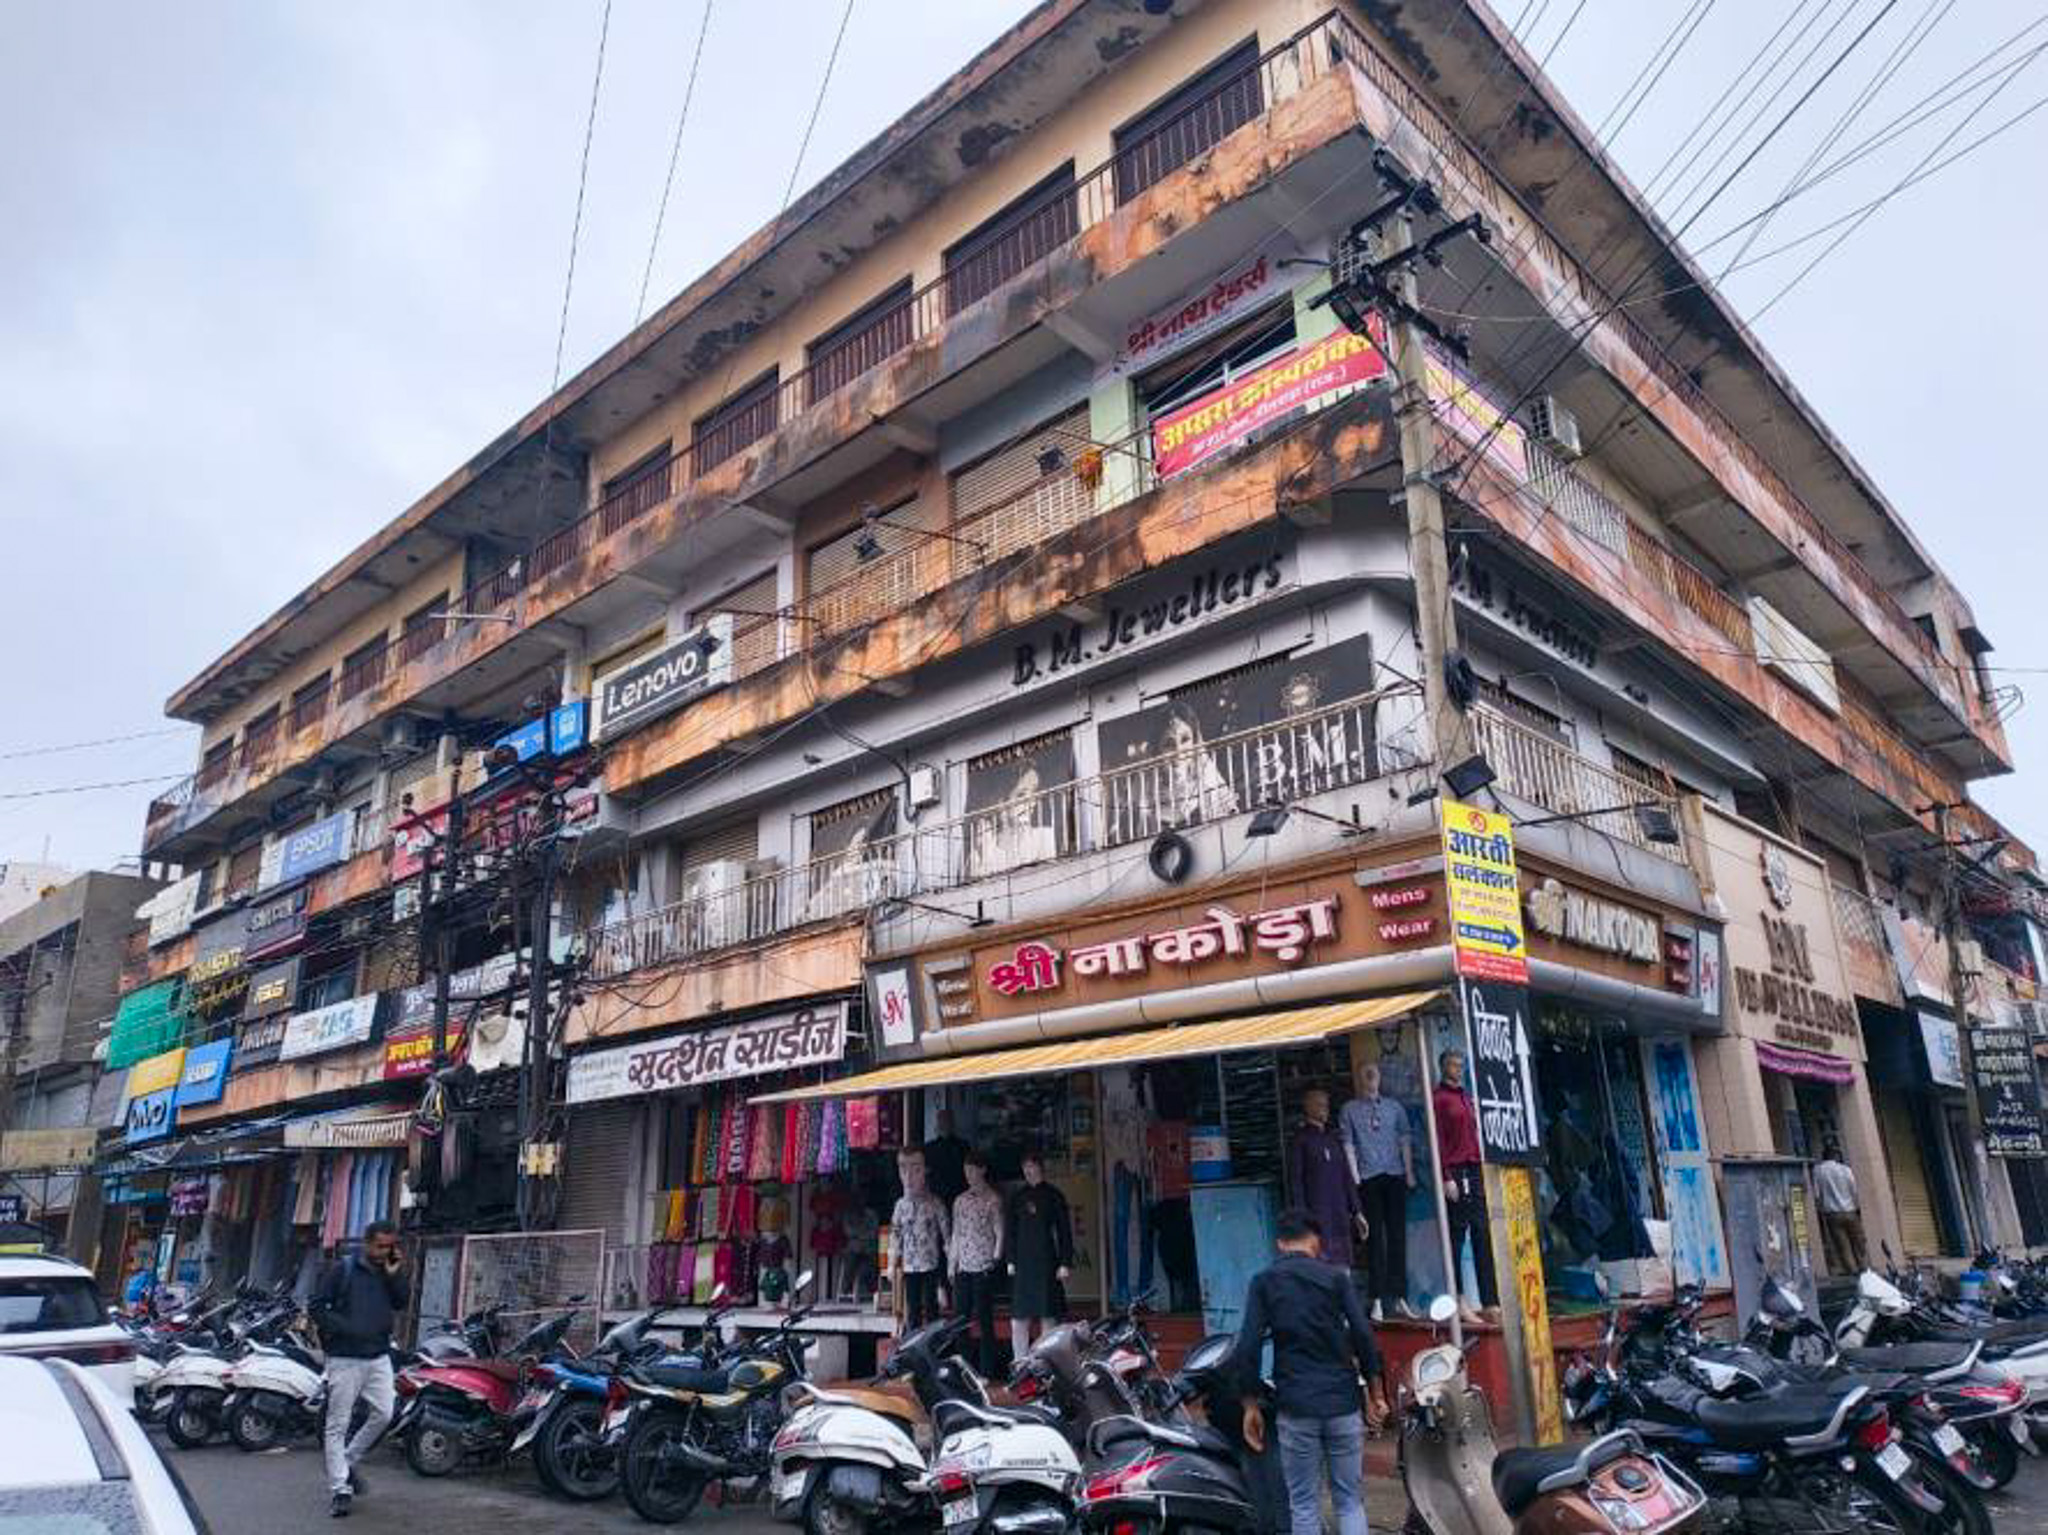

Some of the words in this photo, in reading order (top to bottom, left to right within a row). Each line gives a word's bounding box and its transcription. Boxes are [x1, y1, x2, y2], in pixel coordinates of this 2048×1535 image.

[1099, 551, 1283, 652] Jewellers
[607, 650, 698, 716] Lenovo
[1372, 890, 1425, 907] Mens
[1379, 921, 1431, 939] Wear
[989, 942, 1062, 995] श्री
[1070, 899, 1336, 976] नाकोड़ा
